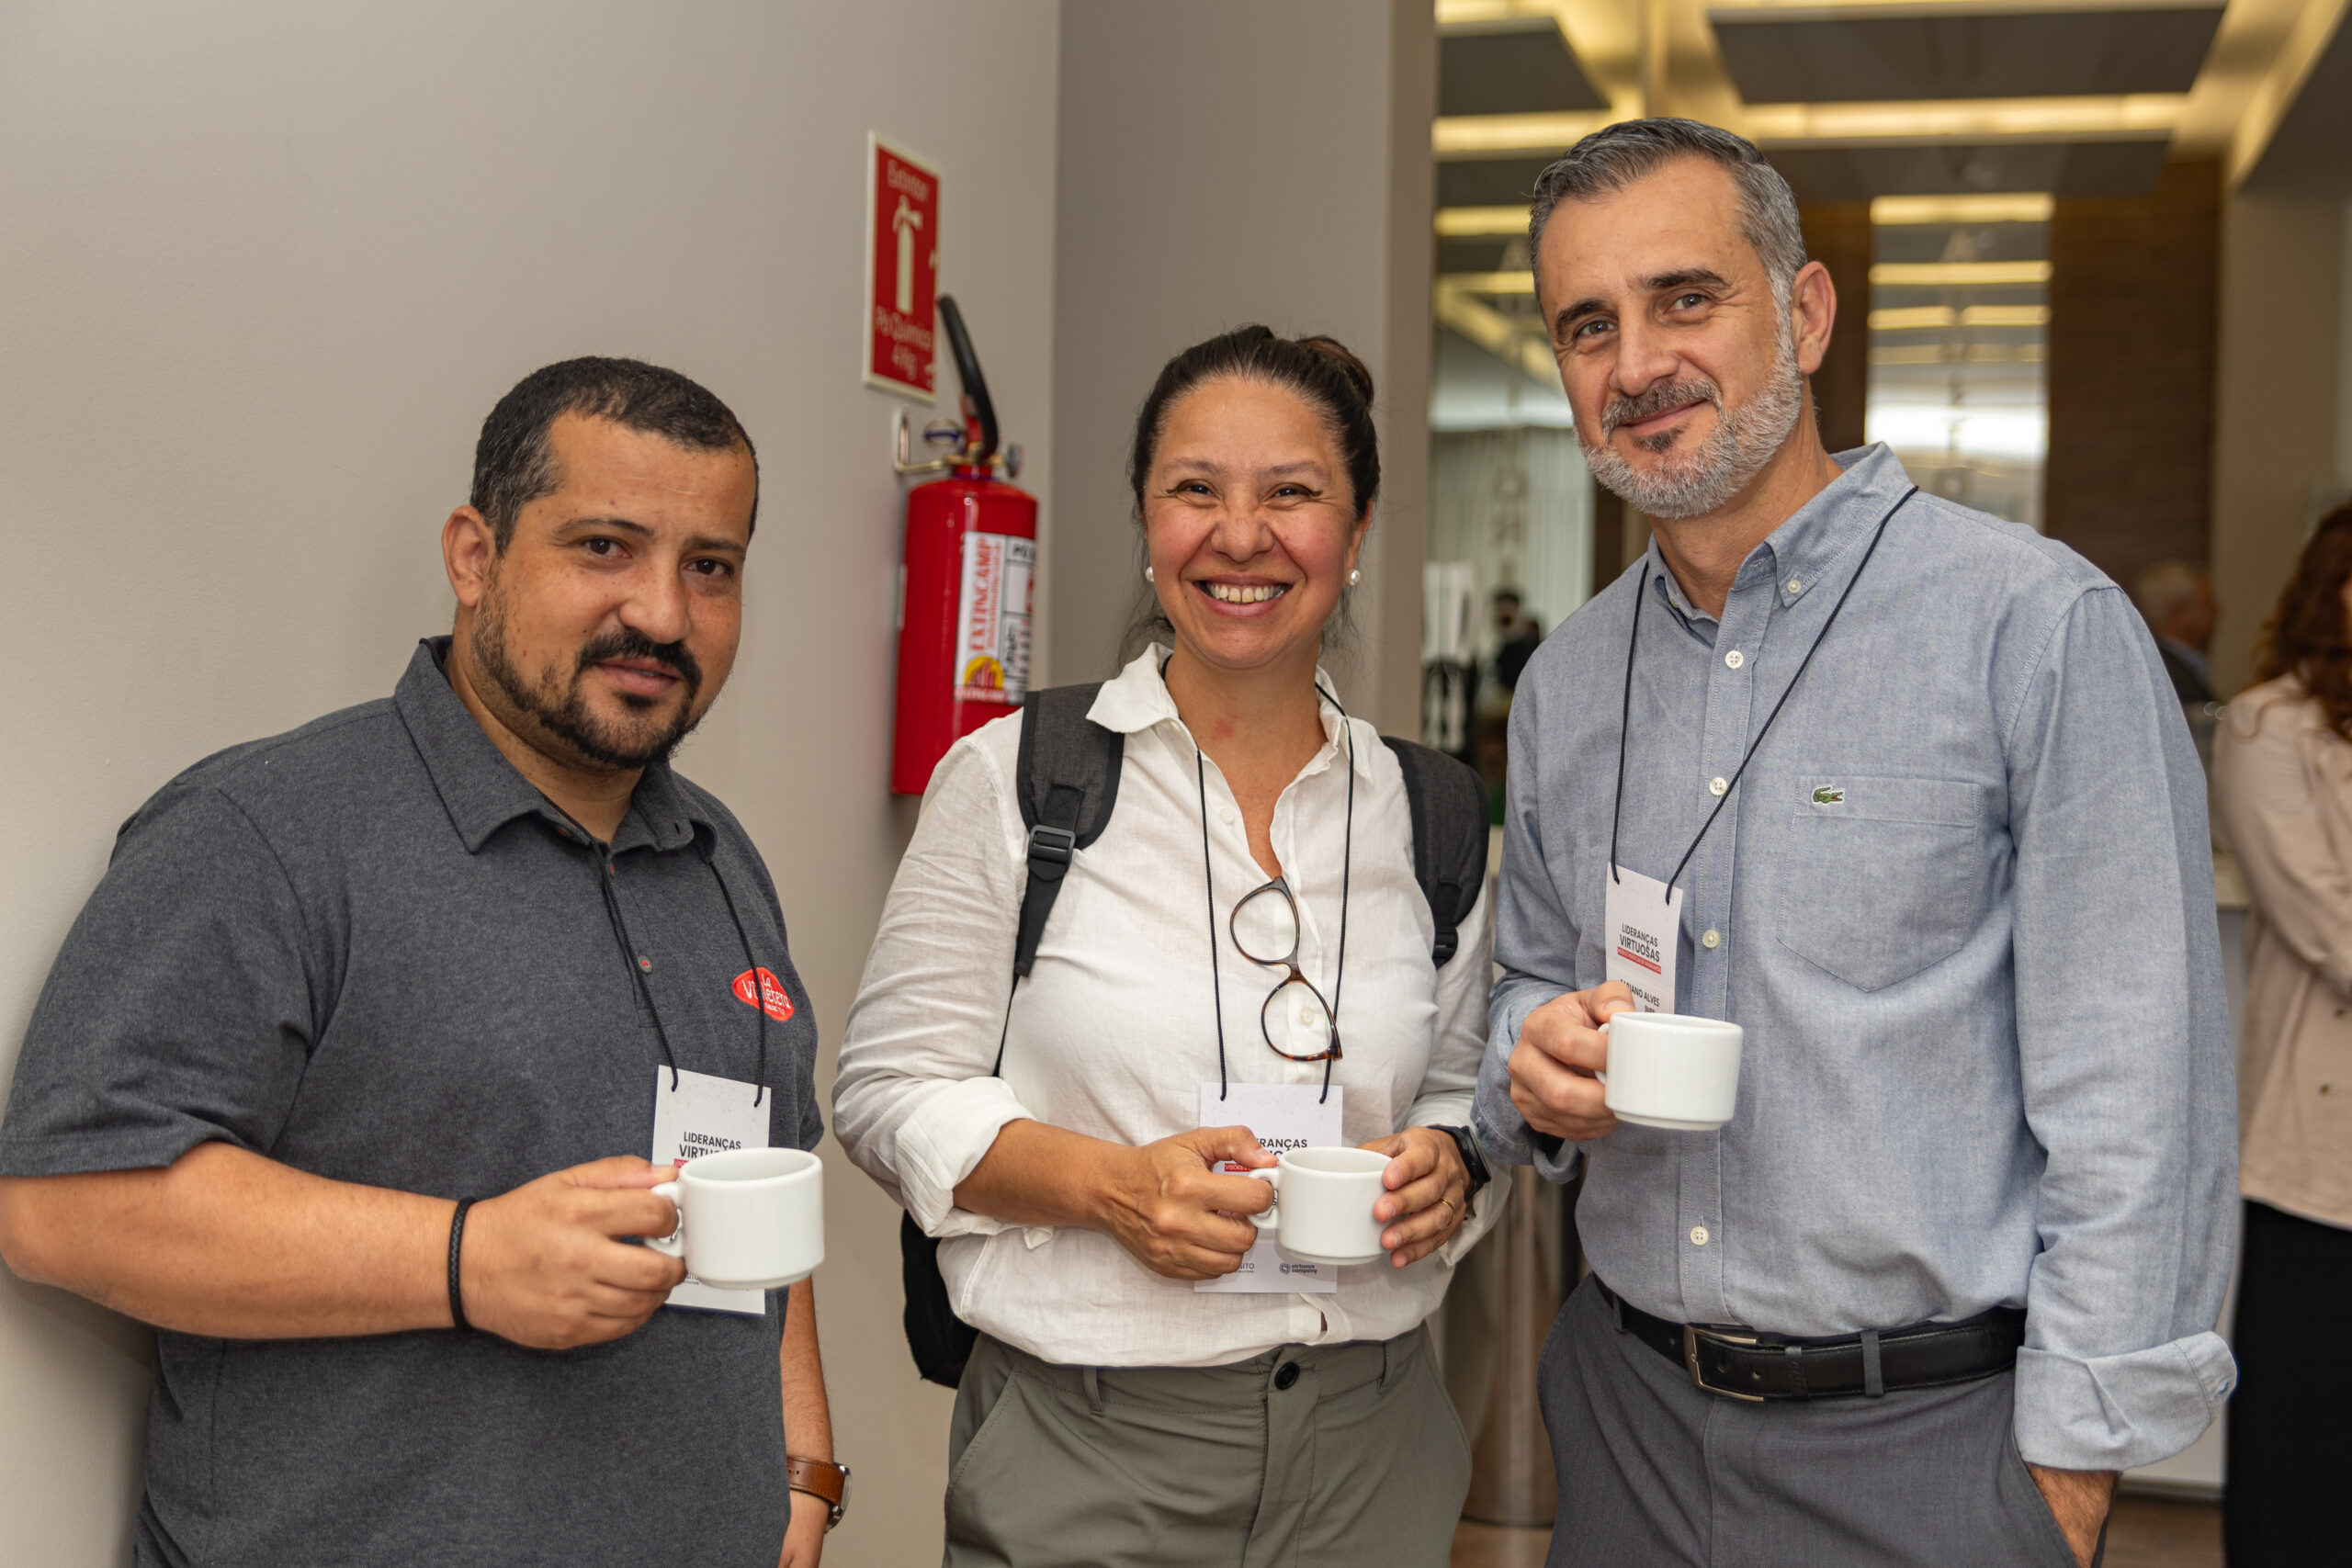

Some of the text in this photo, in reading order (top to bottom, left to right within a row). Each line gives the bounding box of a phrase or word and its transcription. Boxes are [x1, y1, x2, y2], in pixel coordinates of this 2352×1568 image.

[969, 536, 992, 651] EXTINCAMP
[1622, 923, 1658, 947] LIDERANÇAS
[1620, 933, 1660, 963] VIRTUOSAS
[1644, 992, 1660, 1007] ALVES
[684, 1131, 741, 1151] LIDERANÇAS
